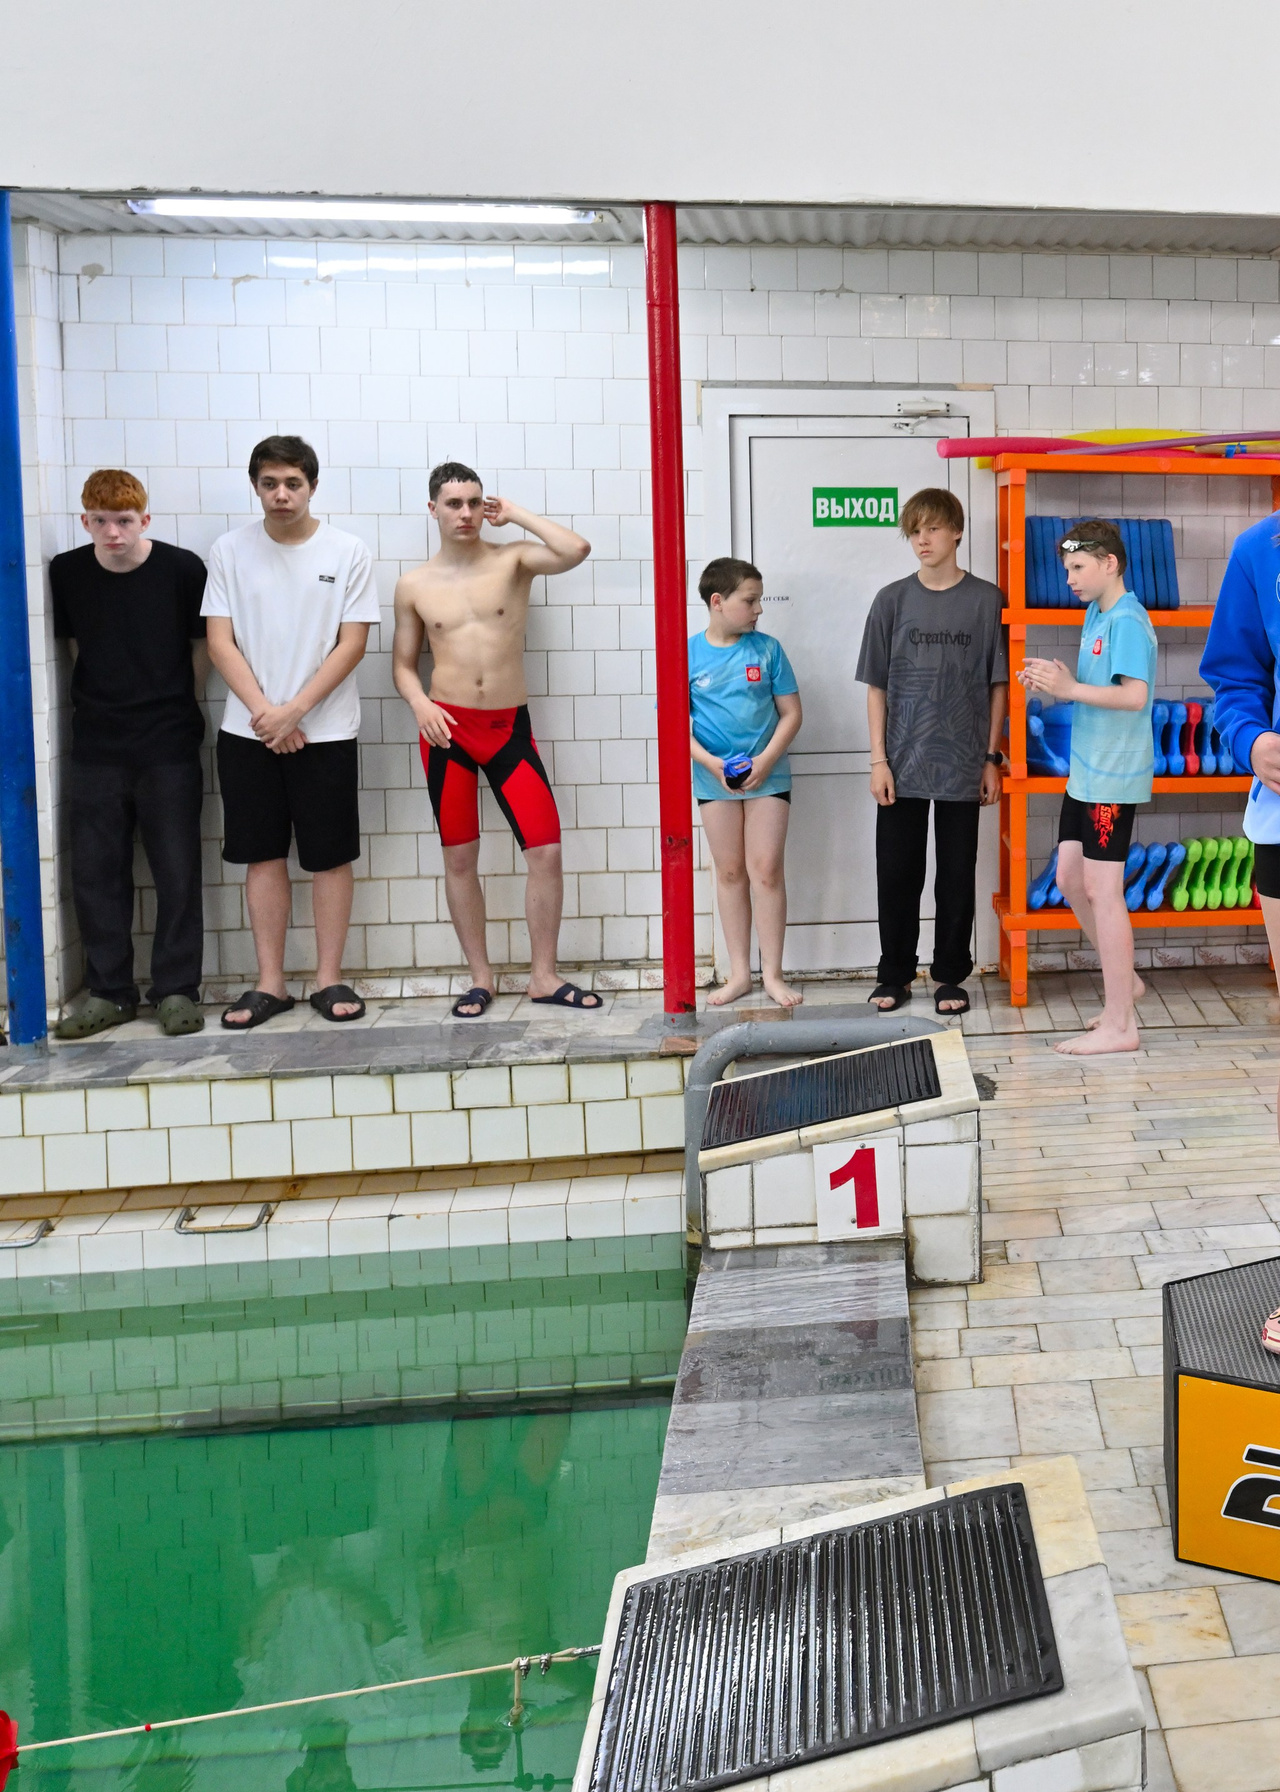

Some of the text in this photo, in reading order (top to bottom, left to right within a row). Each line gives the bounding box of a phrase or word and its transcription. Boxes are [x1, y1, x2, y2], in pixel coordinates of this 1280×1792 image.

[816, 497, 895, 522] ВЫХОД
[908, 628, 972, 649] Creativity
[829, 1147, 880, 1229] 1
